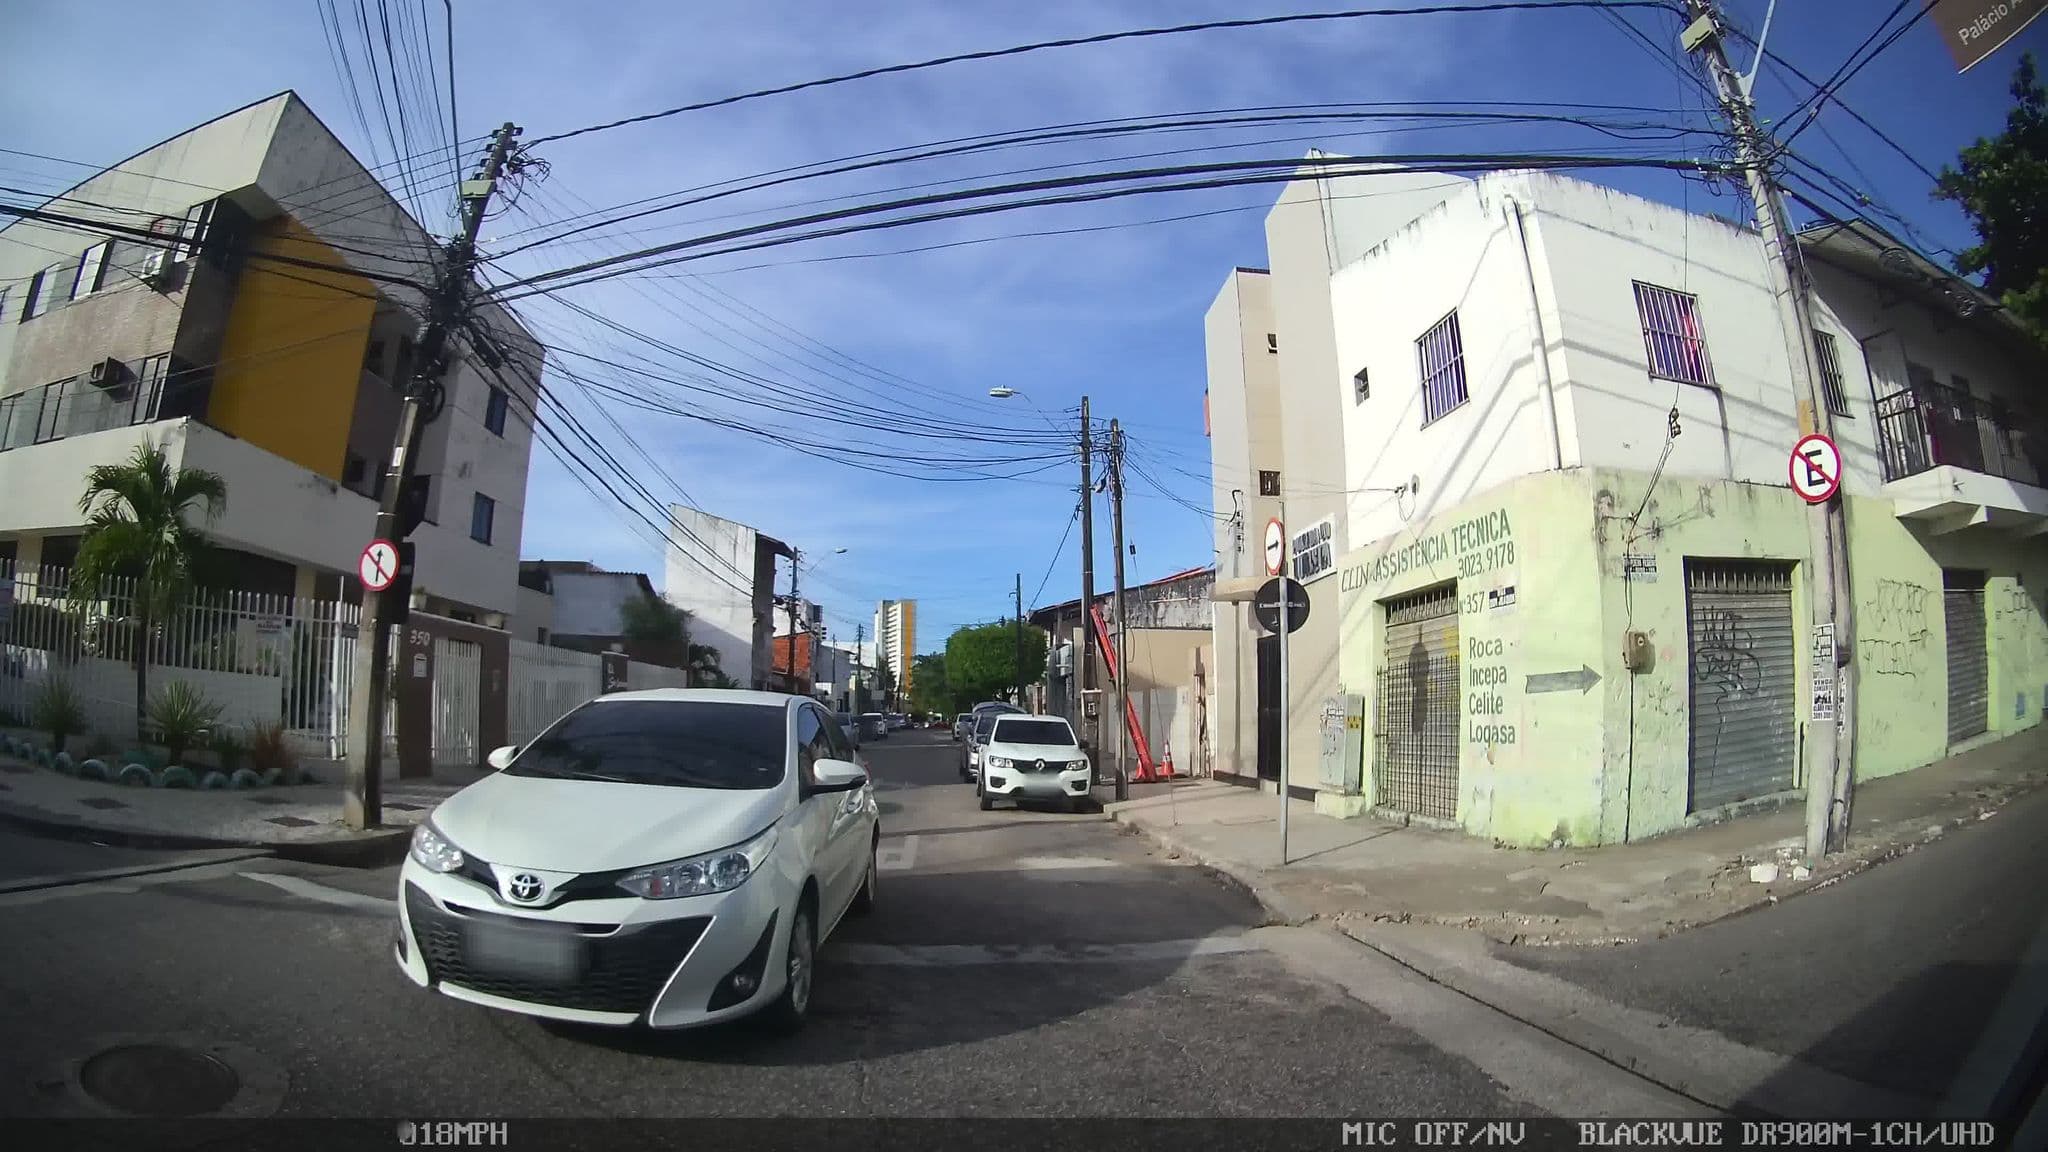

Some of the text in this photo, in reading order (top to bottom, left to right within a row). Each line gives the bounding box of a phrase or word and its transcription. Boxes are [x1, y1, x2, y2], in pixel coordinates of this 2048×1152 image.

[1958, 3, 2008, 46] Palácio
[1805, 449, 1826, 487] E
[1469, 636, 1504, 660] Roca
[1469, 663, 1507, 691] Incepa
[1469, 691, 1504, 715] Celite
